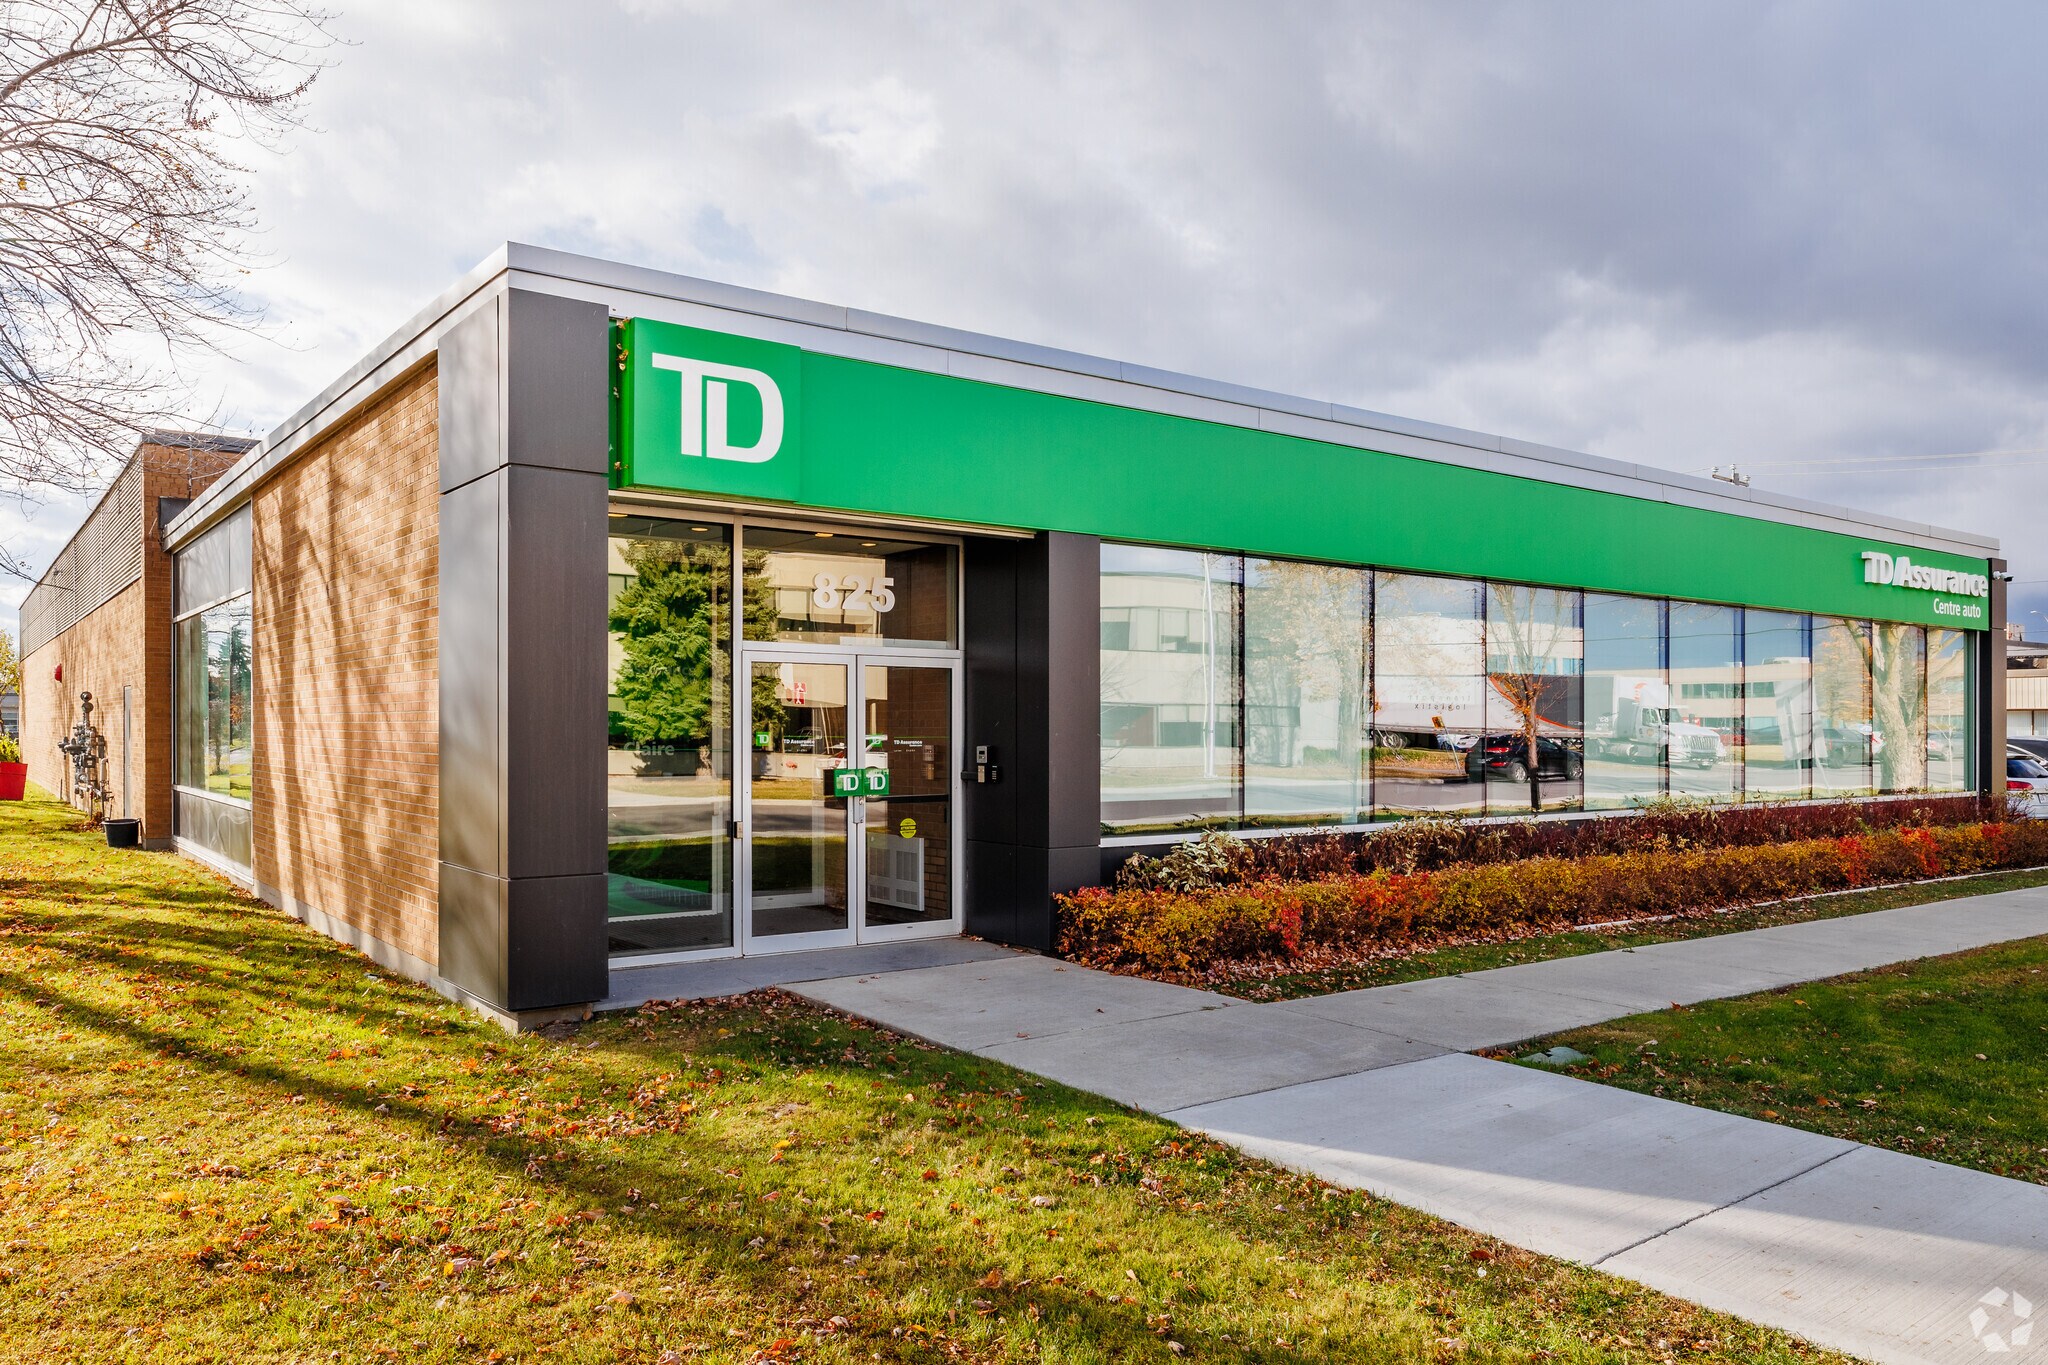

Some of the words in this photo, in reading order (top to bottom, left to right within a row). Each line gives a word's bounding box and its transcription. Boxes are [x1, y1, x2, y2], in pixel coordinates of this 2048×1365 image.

[651, 352, 785, 464] TD
[1861, 551, 1894, 584] TD
[1892, 556, 1989, 598] Assurance
[813, 572, 896, 613] 825
[1933, 598, 1961, 616] Centre
[1962, 604, 1981, 618] auto
[757, 734, 769, 744] TD
[838, 774, 859, 791] TD
[866, 773, 886, 790] TD
